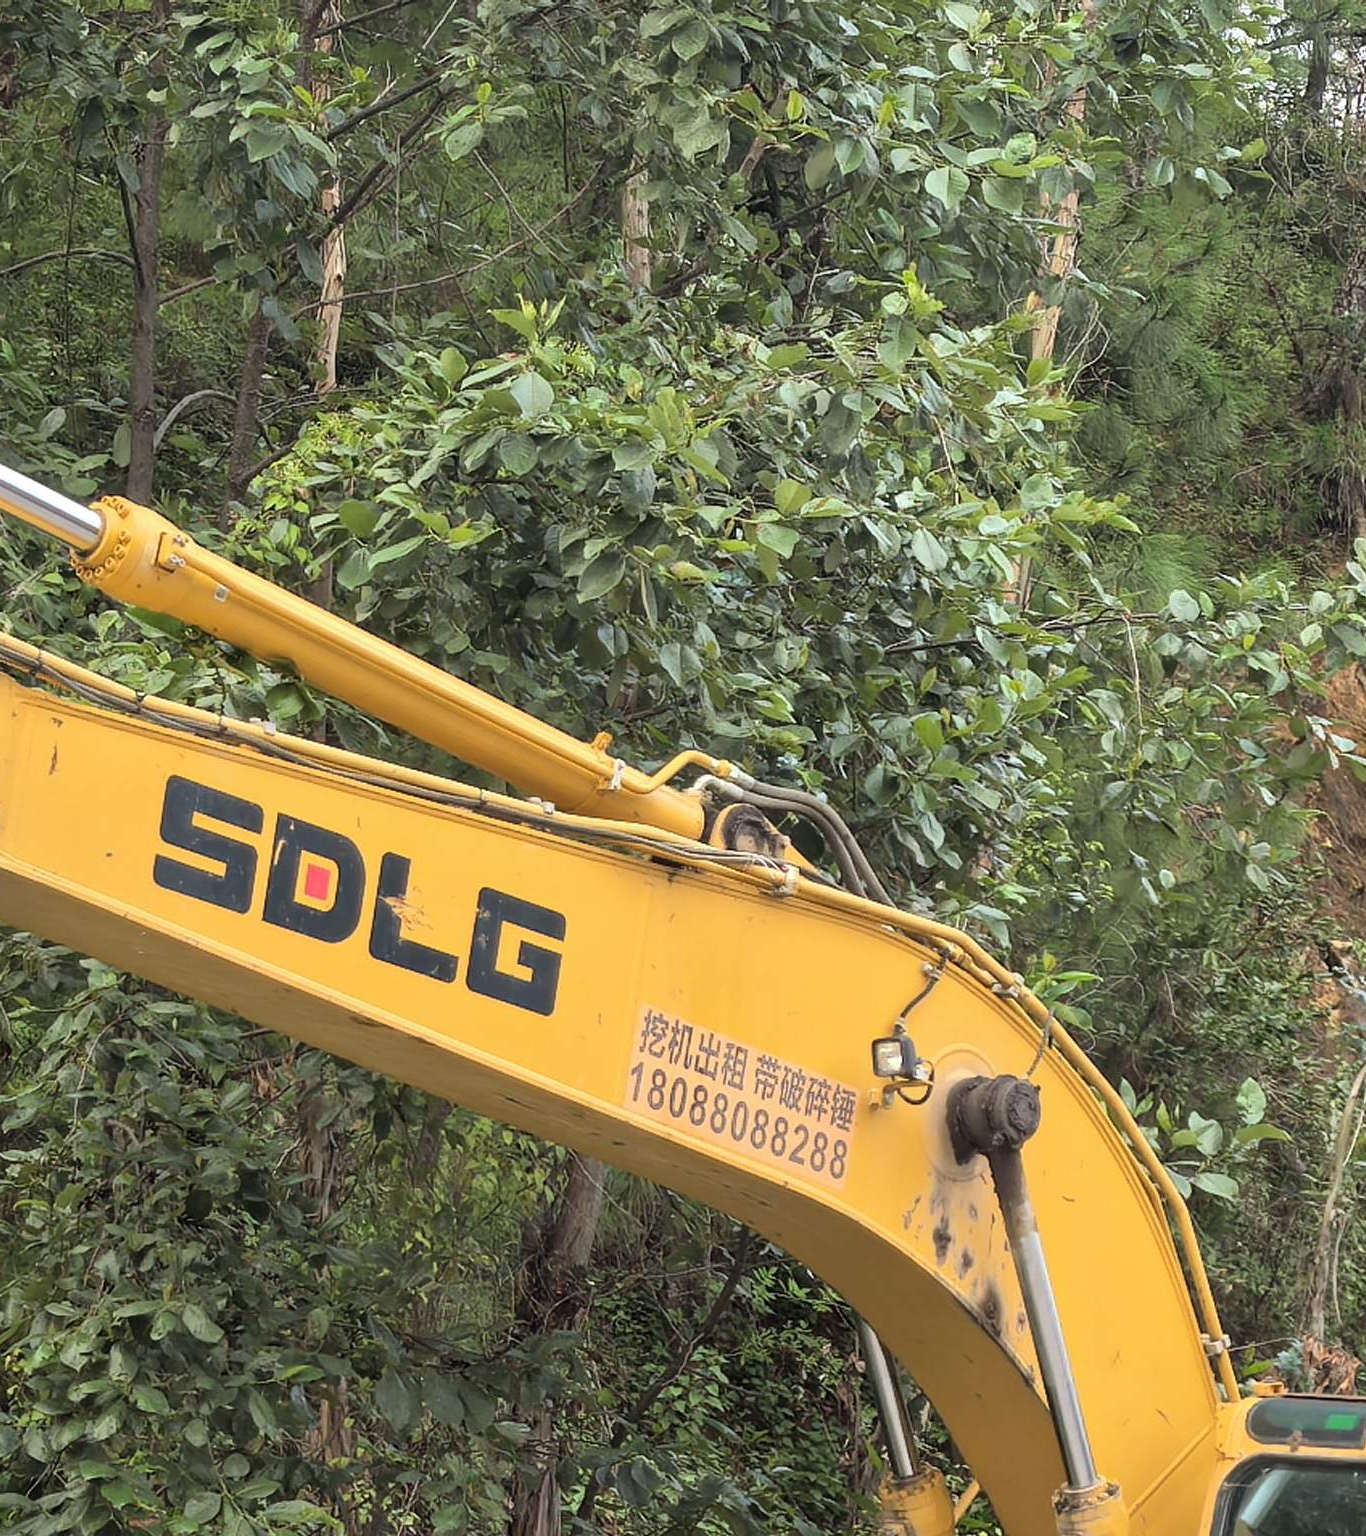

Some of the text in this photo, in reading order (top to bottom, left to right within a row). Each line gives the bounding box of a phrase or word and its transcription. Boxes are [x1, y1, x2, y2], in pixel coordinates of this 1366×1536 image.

[153, 774, 567, 1017] SDLG
[630, 1061, 848, 1180] 18088088288
[639, 1009, 856, 1132] 挖机出租 带破碎锤
